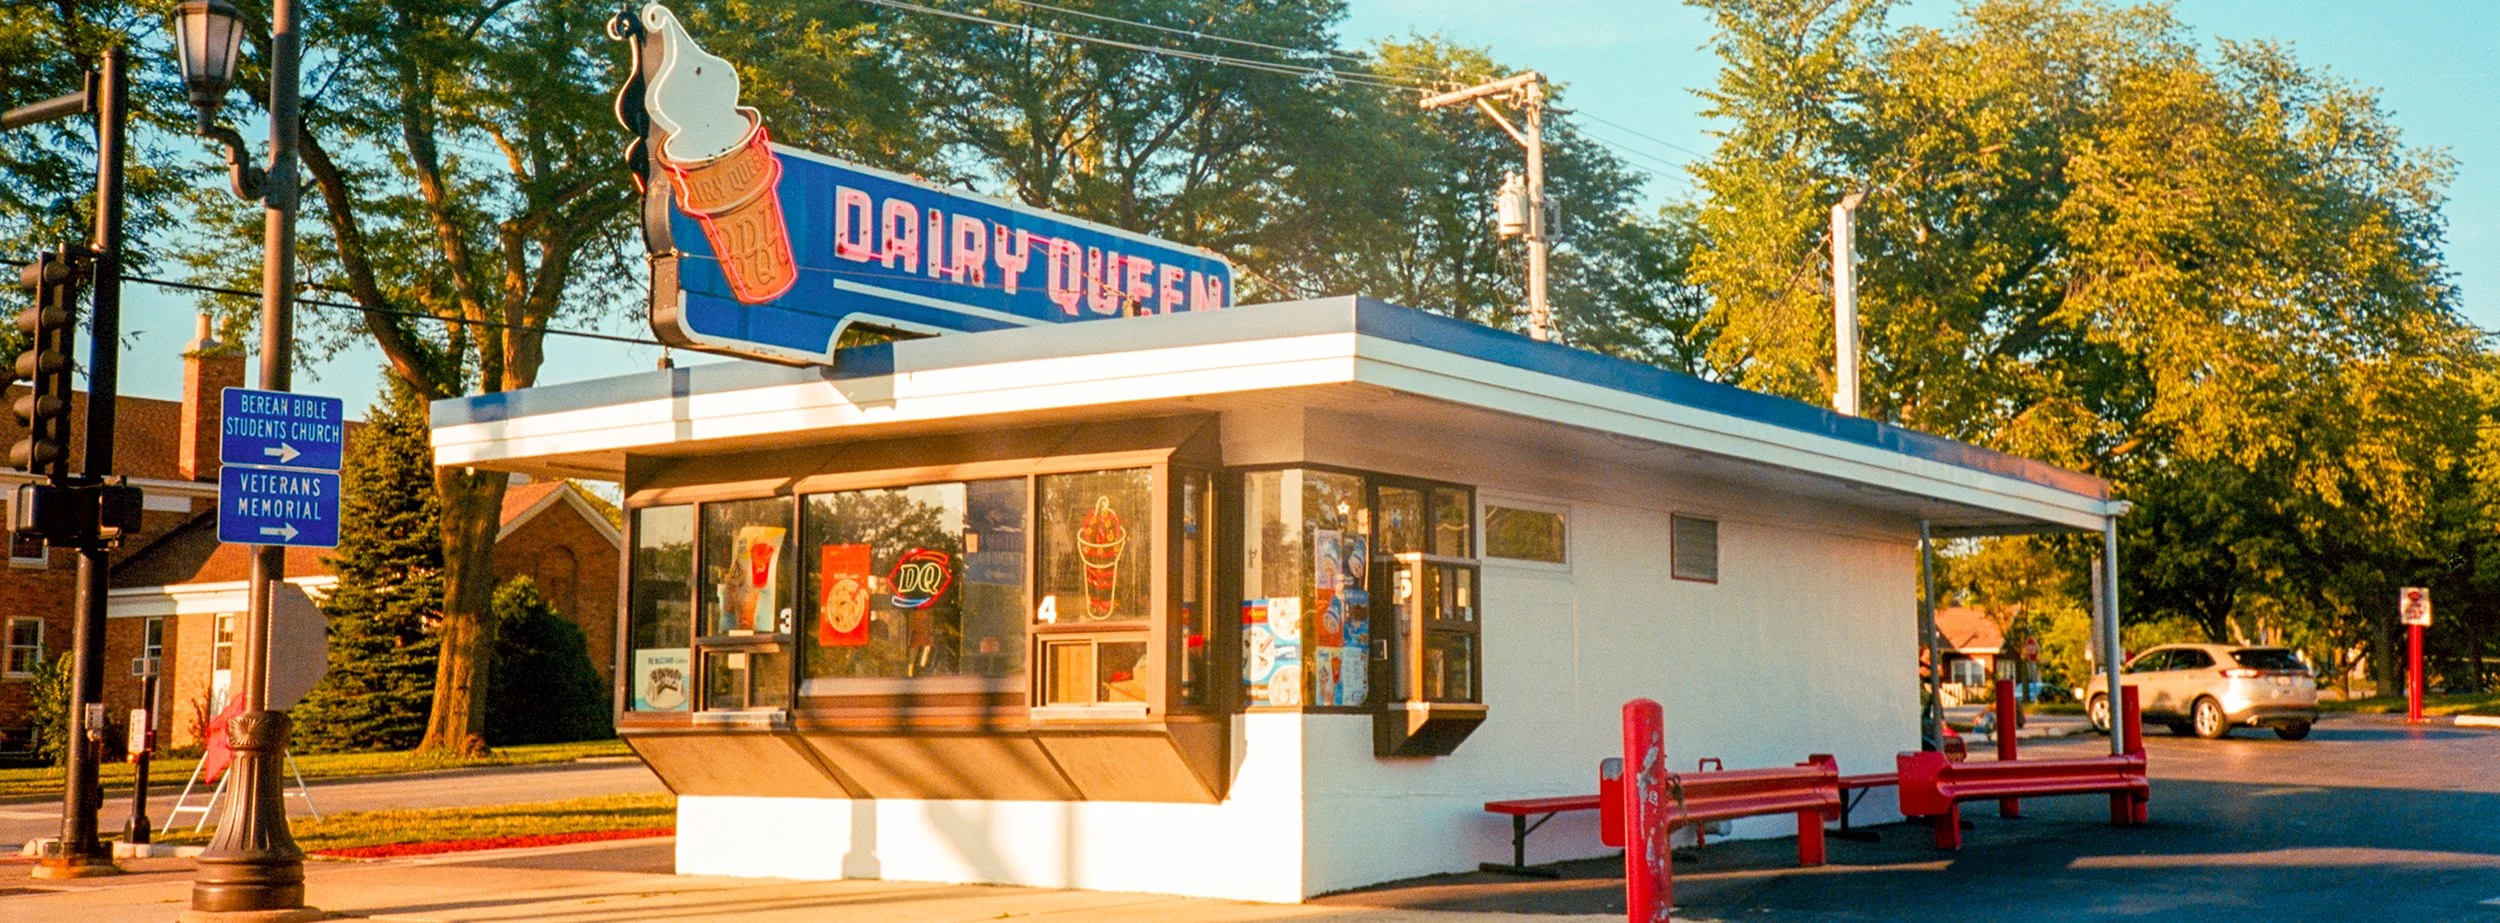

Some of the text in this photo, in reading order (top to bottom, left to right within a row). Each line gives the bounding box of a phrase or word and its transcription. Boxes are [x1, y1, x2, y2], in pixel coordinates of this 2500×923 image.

[834, 184, 1224, 317] DAIRY QUEEN
[240, 394, 328, 420] BEREAN BIBLE
[226, 416, 340, 444] STUDENTS CHURCH
[240, 473, 321, 497] VETERANS
[238, 497, 322, 521] MEMORIAL
[898, 562, 942, 595] DQ
[1394, 569, 1413, 601] 5
[779, 607, 793, 635] 3
[1037, 594, 1057, 625] 4
